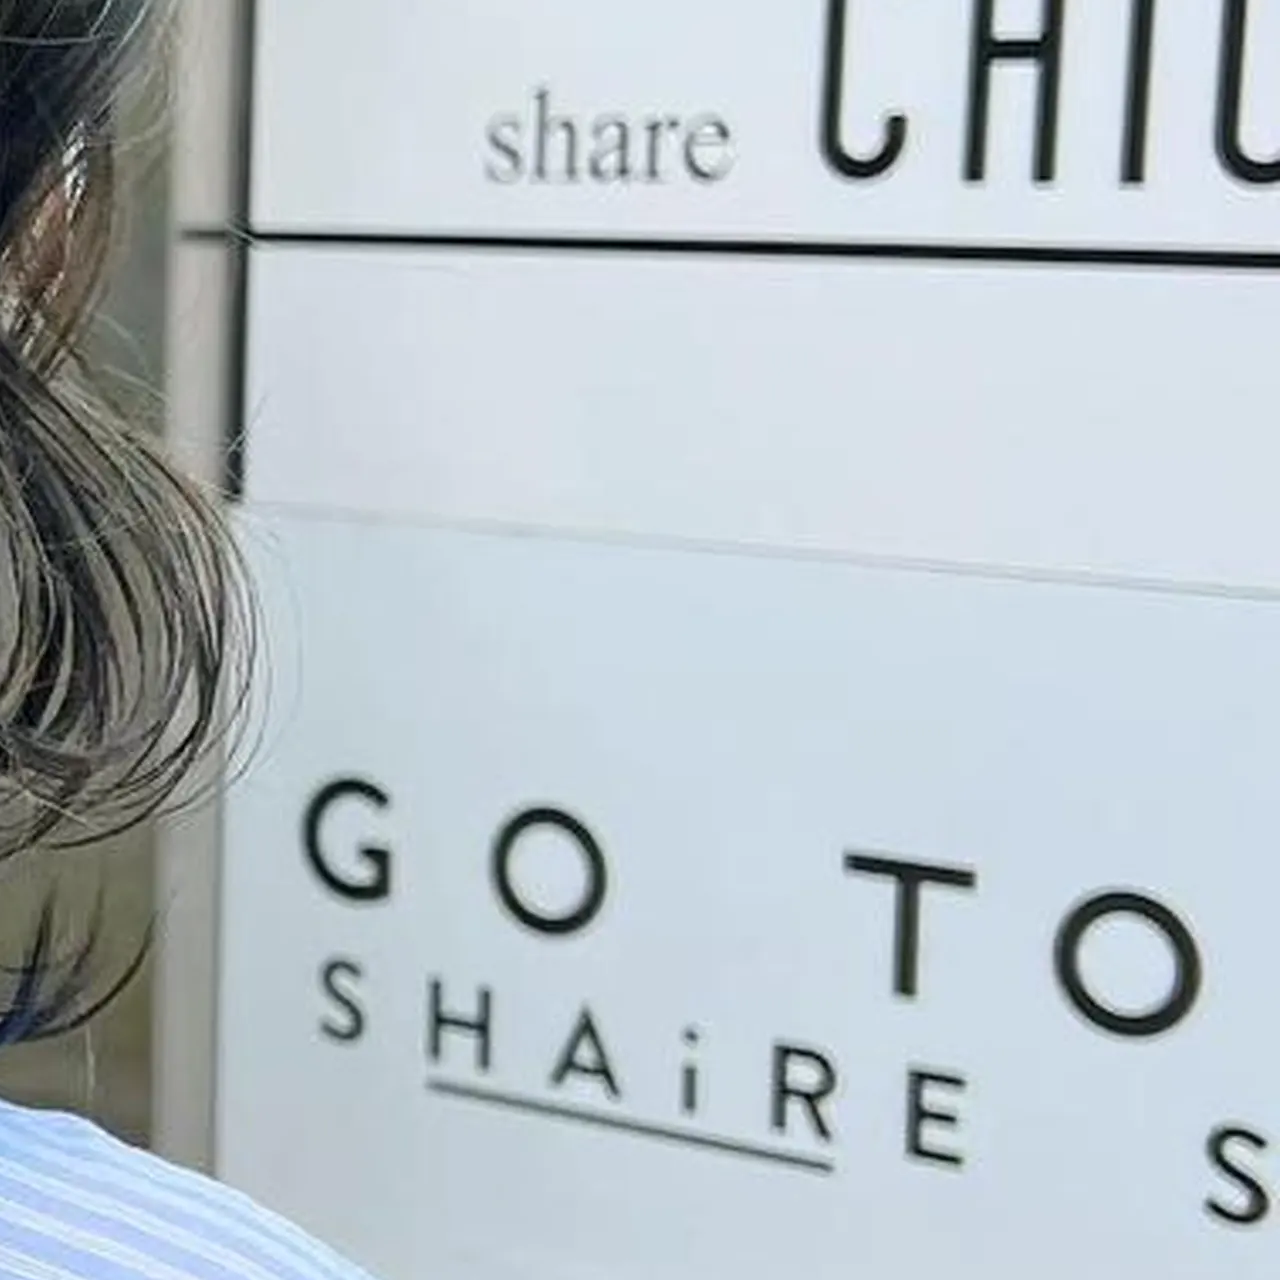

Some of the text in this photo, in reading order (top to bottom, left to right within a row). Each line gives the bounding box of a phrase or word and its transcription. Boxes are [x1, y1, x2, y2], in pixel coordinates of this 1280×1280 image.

[484, 86, 736, 184] share
[300, 776, 1203, 1038] GO TO
